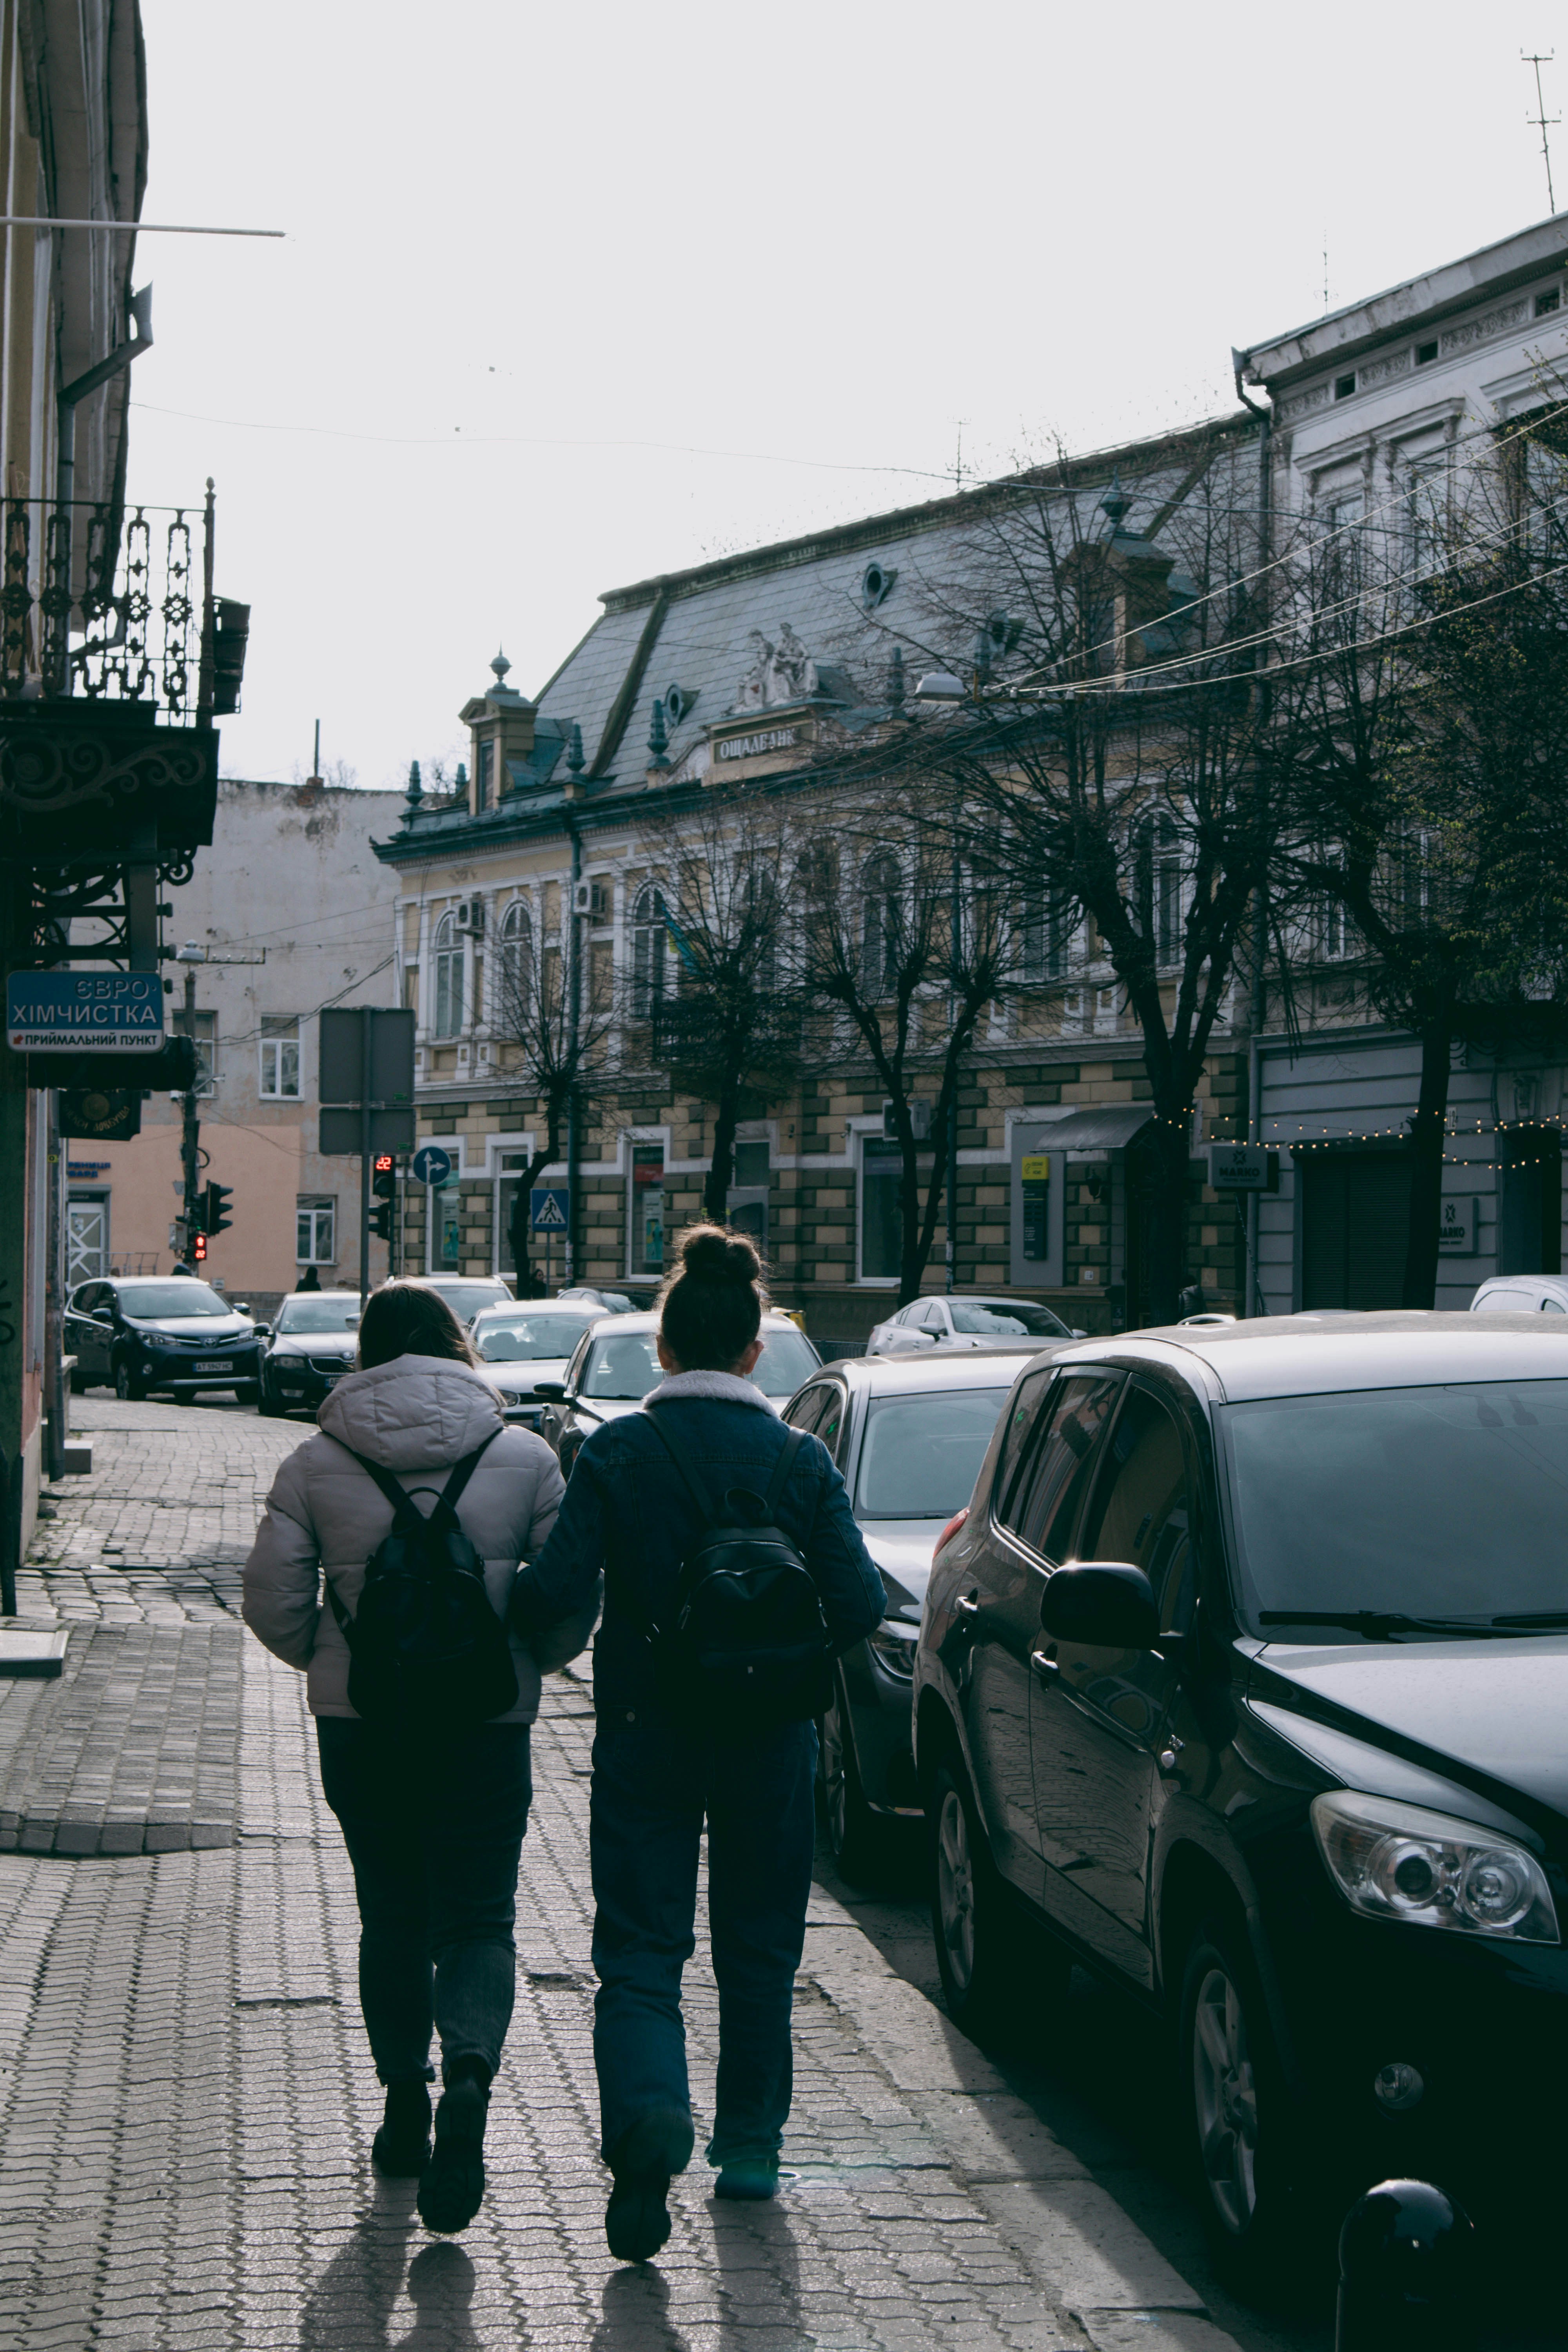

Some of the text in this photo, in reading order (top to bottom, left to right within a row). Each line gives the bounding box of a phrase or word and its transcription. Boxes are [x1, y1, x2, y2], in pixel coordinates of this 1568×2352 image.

[720, 728, 795, 758] ОЩАДБАНК
[13, 1005, 157, 1023] ХІМЧИСТКА
[25, 1032, 157, 1045] ПРИЙМАЛЬНИЙ ПУНКТ
[376, 1157, 392, 1170] 22
[1219, 1167, 1260, 1176] MARKO
[195, 1249, 206, 1258] 22
